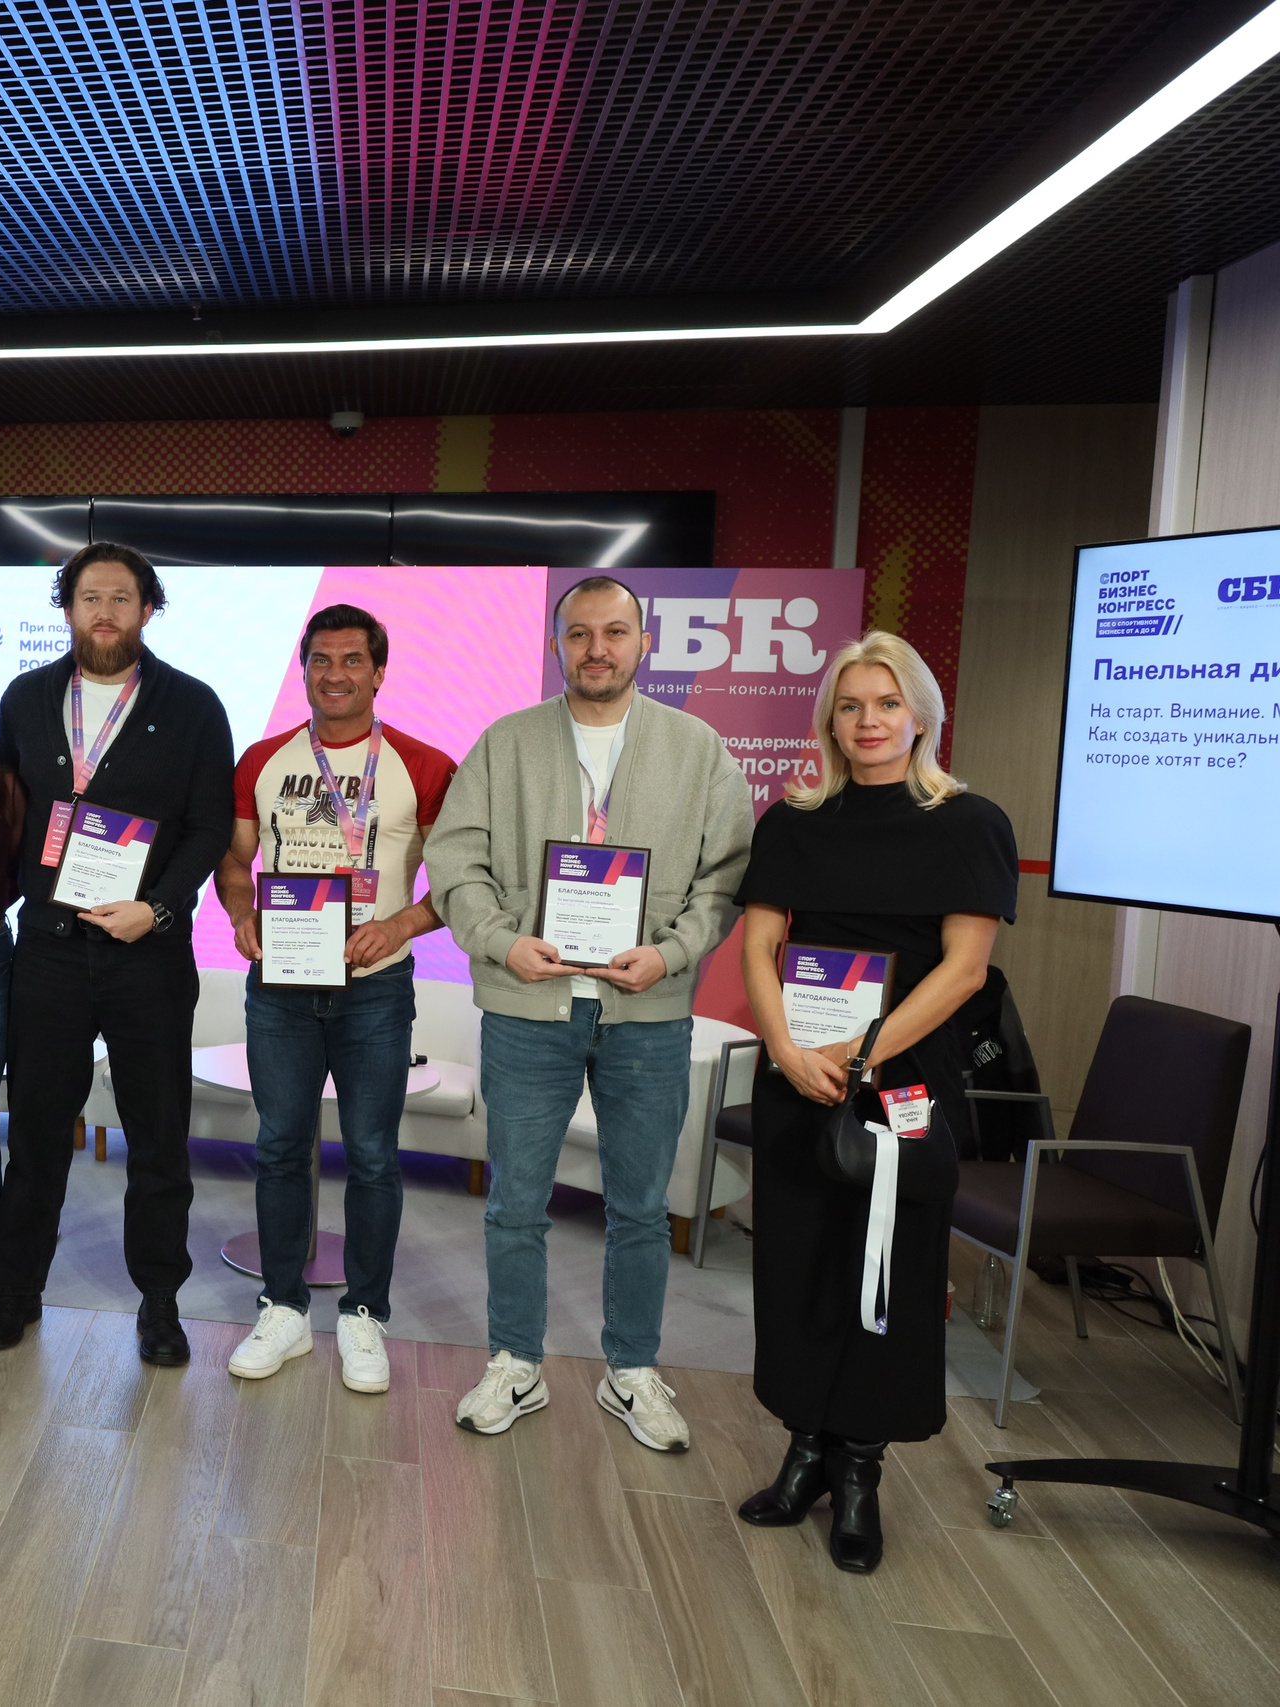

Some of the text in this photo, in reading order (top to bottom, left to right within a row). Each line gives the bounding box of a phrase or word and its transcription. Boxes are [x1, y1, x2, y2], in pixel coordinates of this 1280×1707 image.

[1099, 569, 1150, 585] СПОРТ
[1098, 584, 1158, 599] БИЗНЕС
[1097, 598, 1176, 614] КОНГРЕСС
[19, 621, 72, 634] При под
[1117, 619, 1159, 627] СПОРТИВНОМ
[637, 597, 827, 675] БК
[1094, 658, 1280, 682] Панельная ди
[647, 684, 817, 696] БИЗНЕС КОНСАЛТИН
[1090, 703, 1111, 718] На
[1117, 707, 1163, 721] старт.
[1170, 703, 1265, 719] Внимание.
[1088, 725, 1280, 747] Как создать уникальн
[1086, 752, 1247, 768] которое хотят все?
[285, 827, 347, 849] МАСТЕР
[78, 841, 122, 857] БЛАГОДАРНОСТЬ
[286, 849, 354, 869] СПОРТА
[558, 888, 611, 897] БЛАГОДАРНОСТЬ
[793, 992, 849, 1005] БЛАГОДАРНОСТЬ
